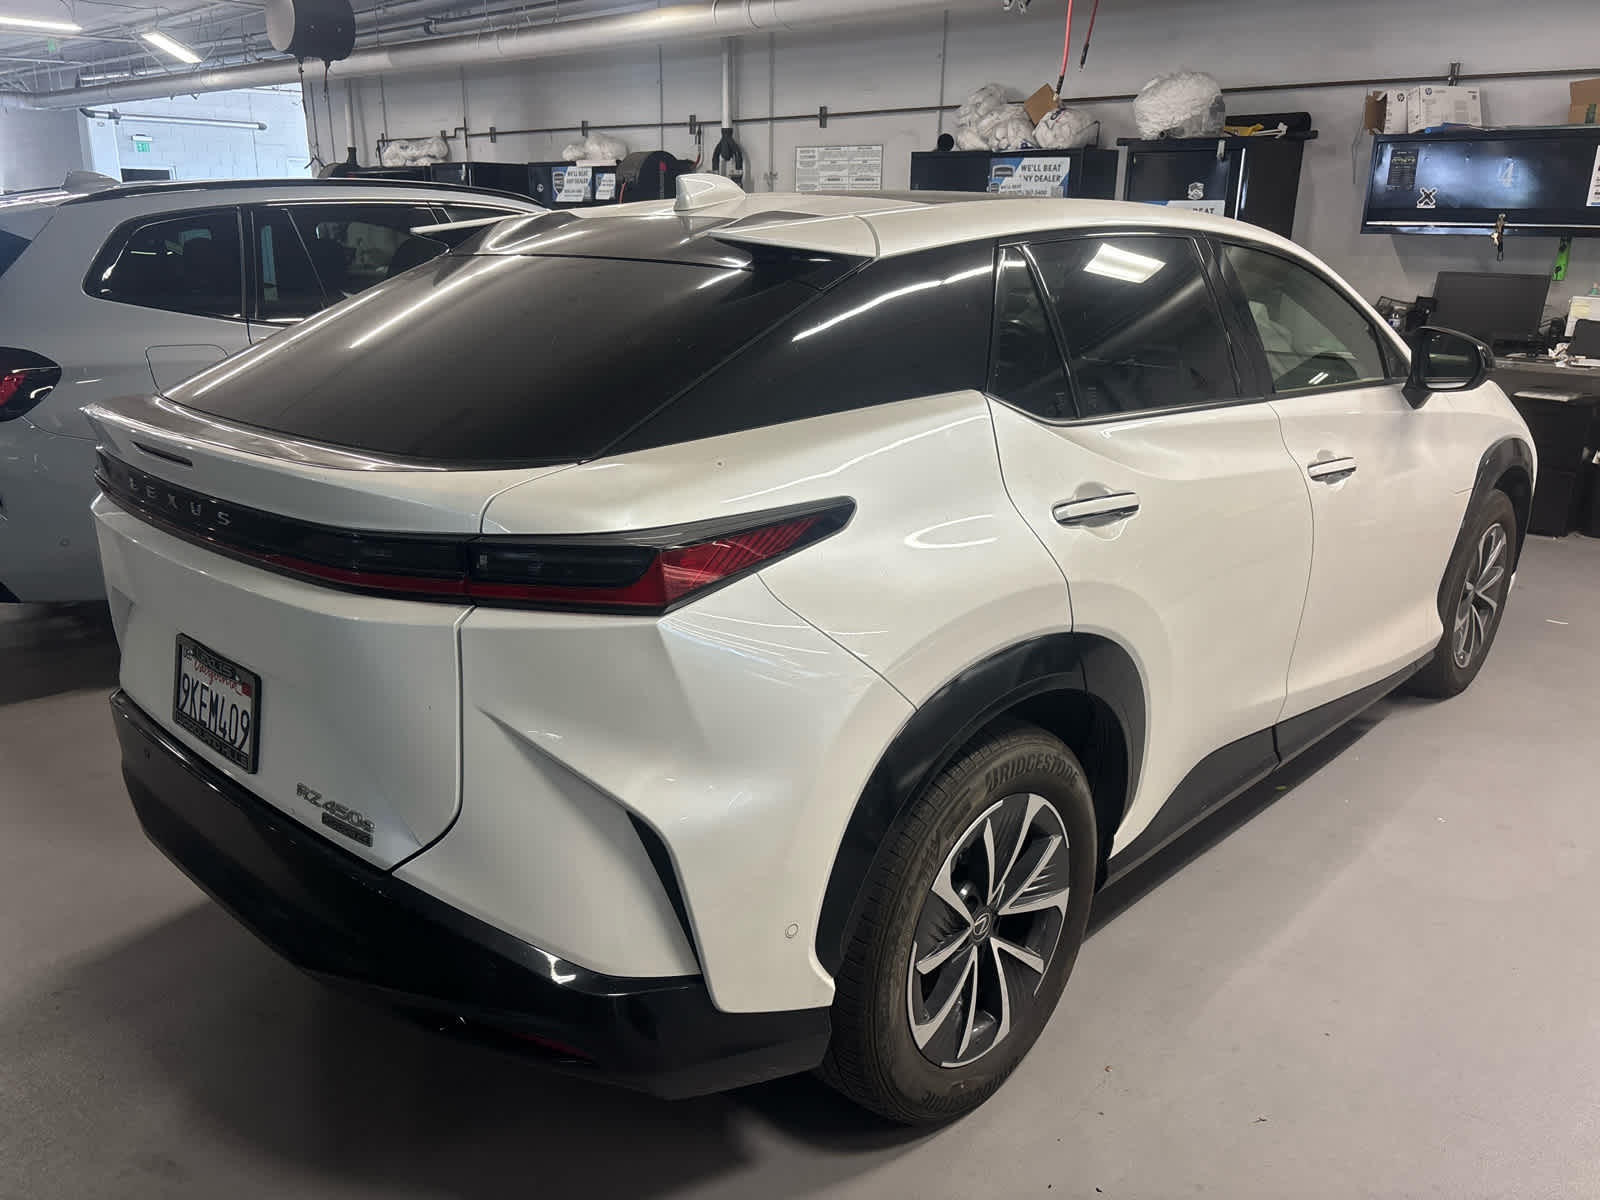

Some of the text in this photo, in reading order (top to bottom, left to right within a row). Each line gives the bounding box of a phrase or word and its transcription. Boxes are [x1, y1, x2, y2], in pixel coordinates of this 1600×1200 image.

[1021, 164, 1062, 172] WE'LL BEAT
[128, 477, 232, 526] LEXUS
[180, 672, 250, 751] 9KEM409
